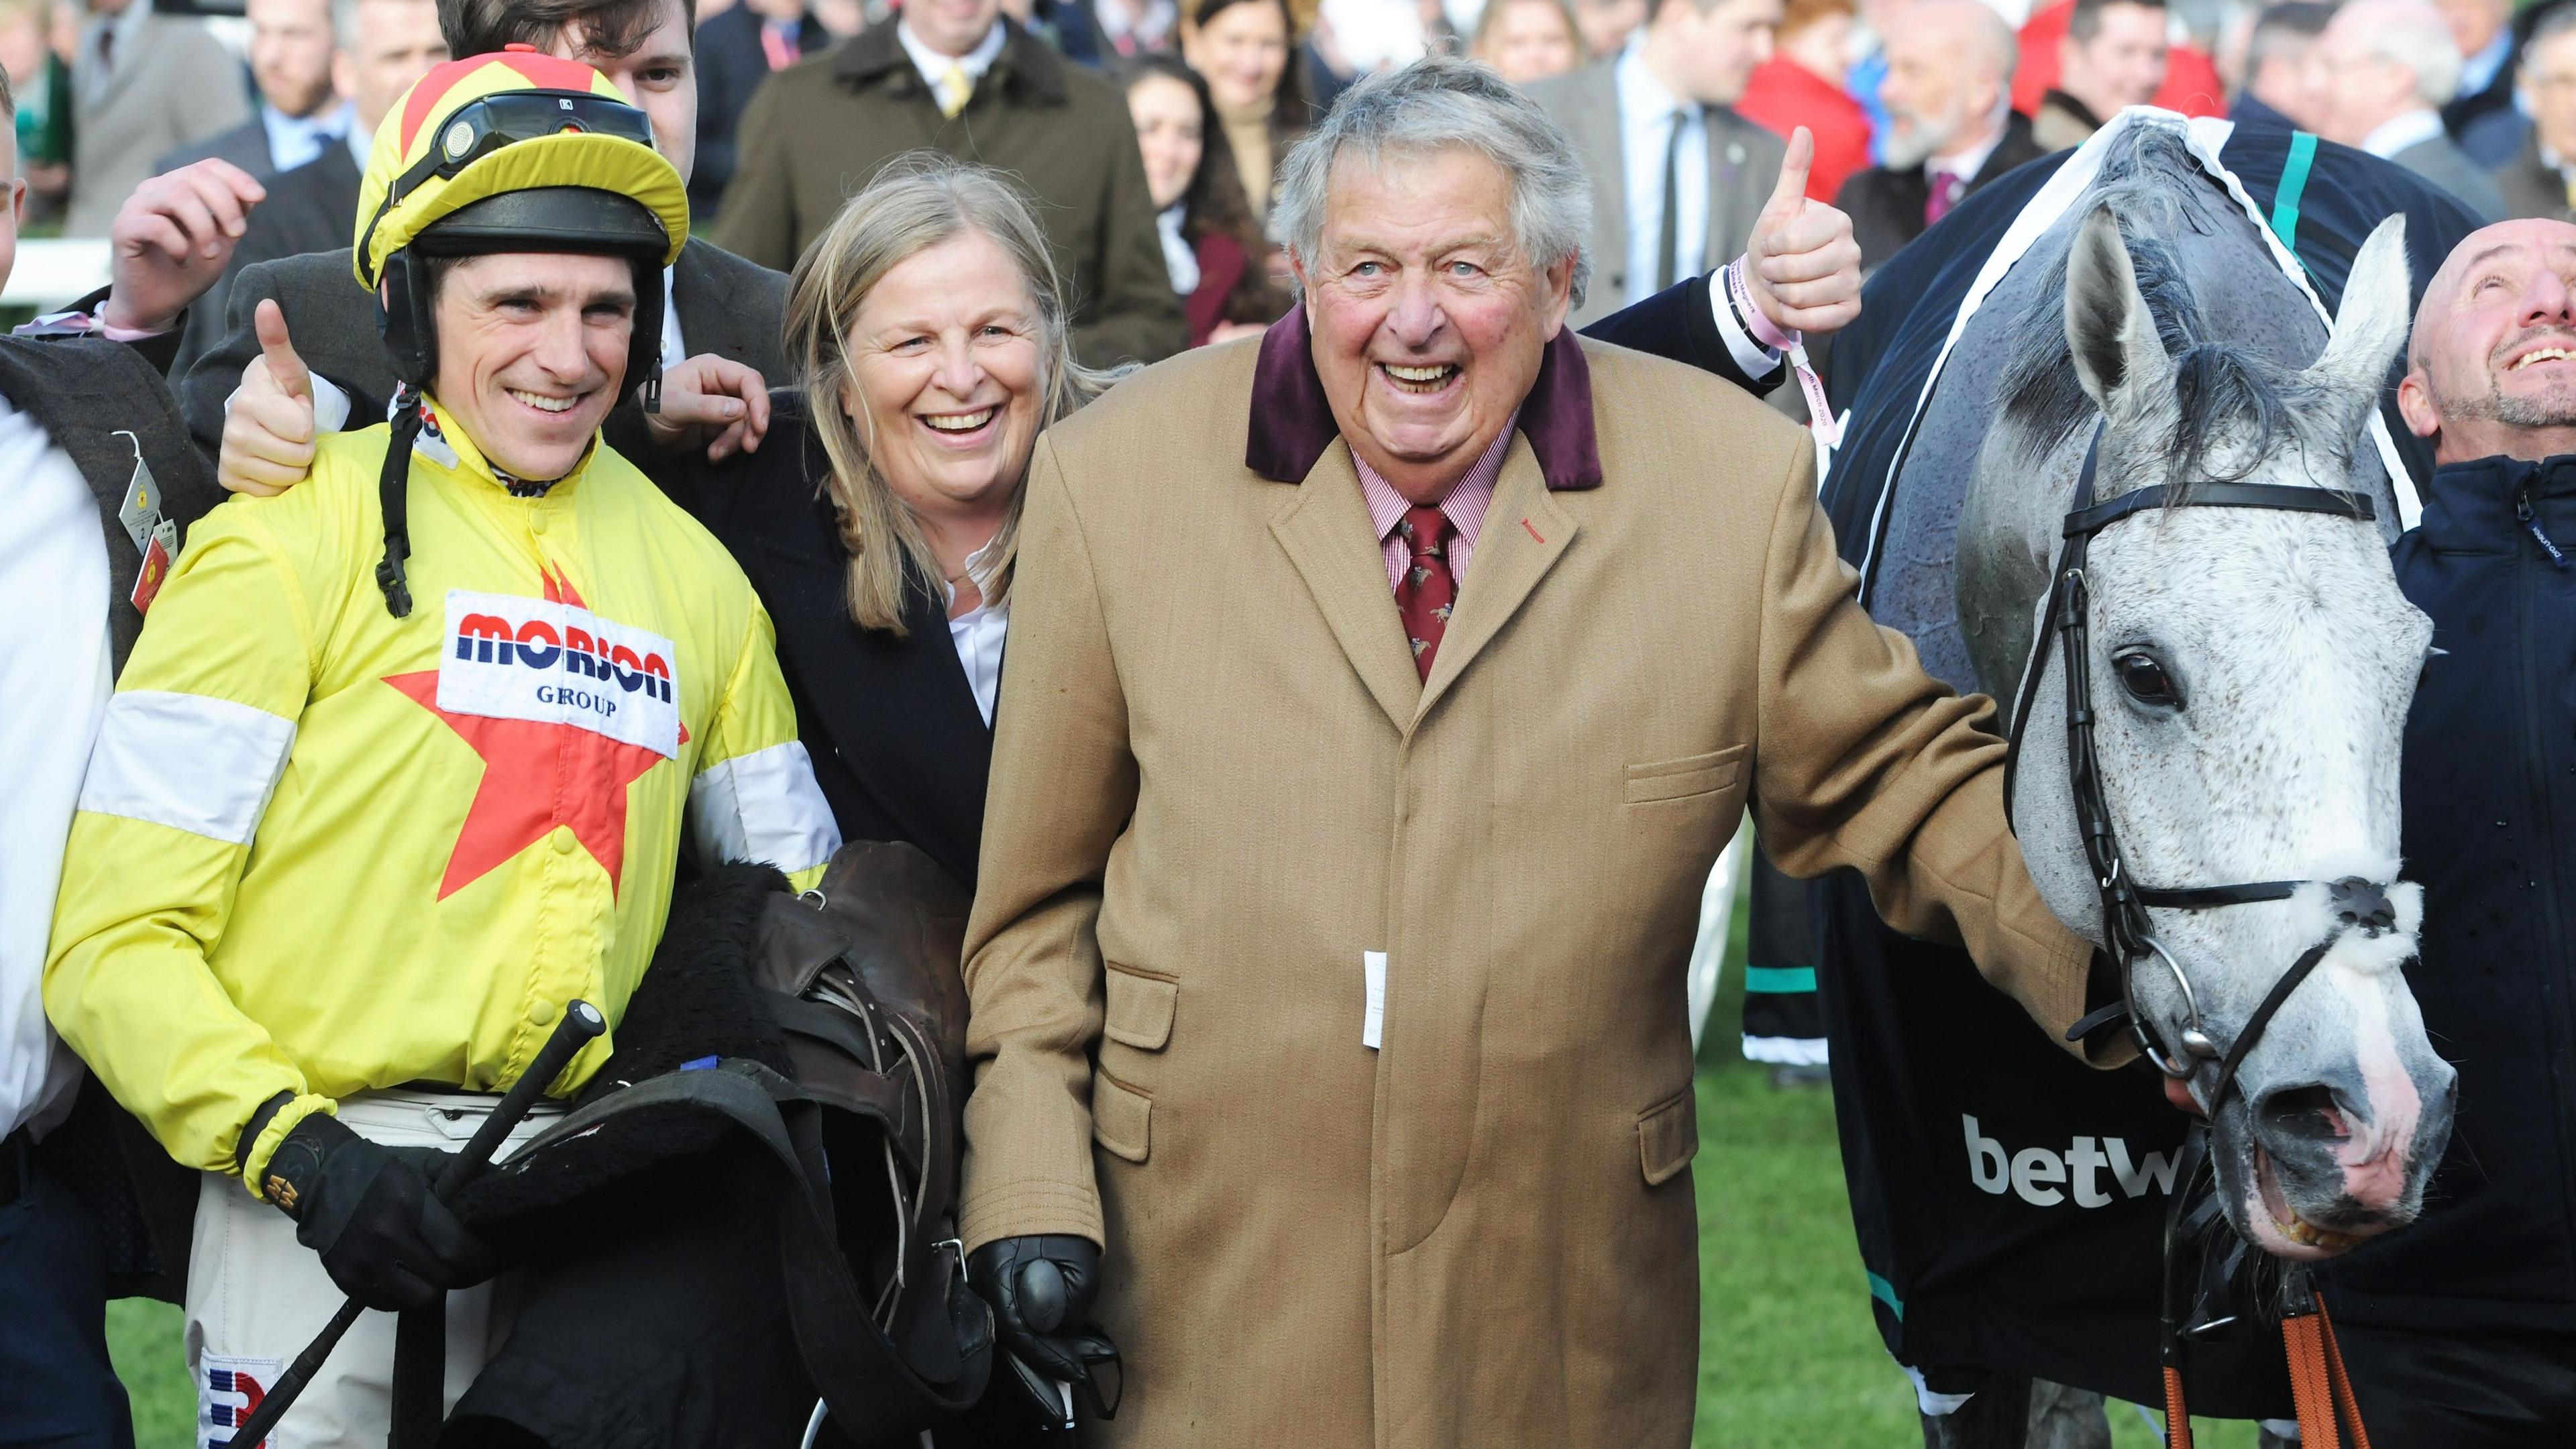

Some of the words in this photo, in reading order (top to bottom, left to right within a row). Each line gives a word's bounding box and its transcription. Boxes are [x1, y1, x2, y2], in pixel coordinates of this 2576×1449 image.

[1812, 384, 1822, 407] March
[1819, 409, 1827, 427] 2020
[537, 685, 616, 717] GROUP
[1962, 1113, 2185, 1208] betw
